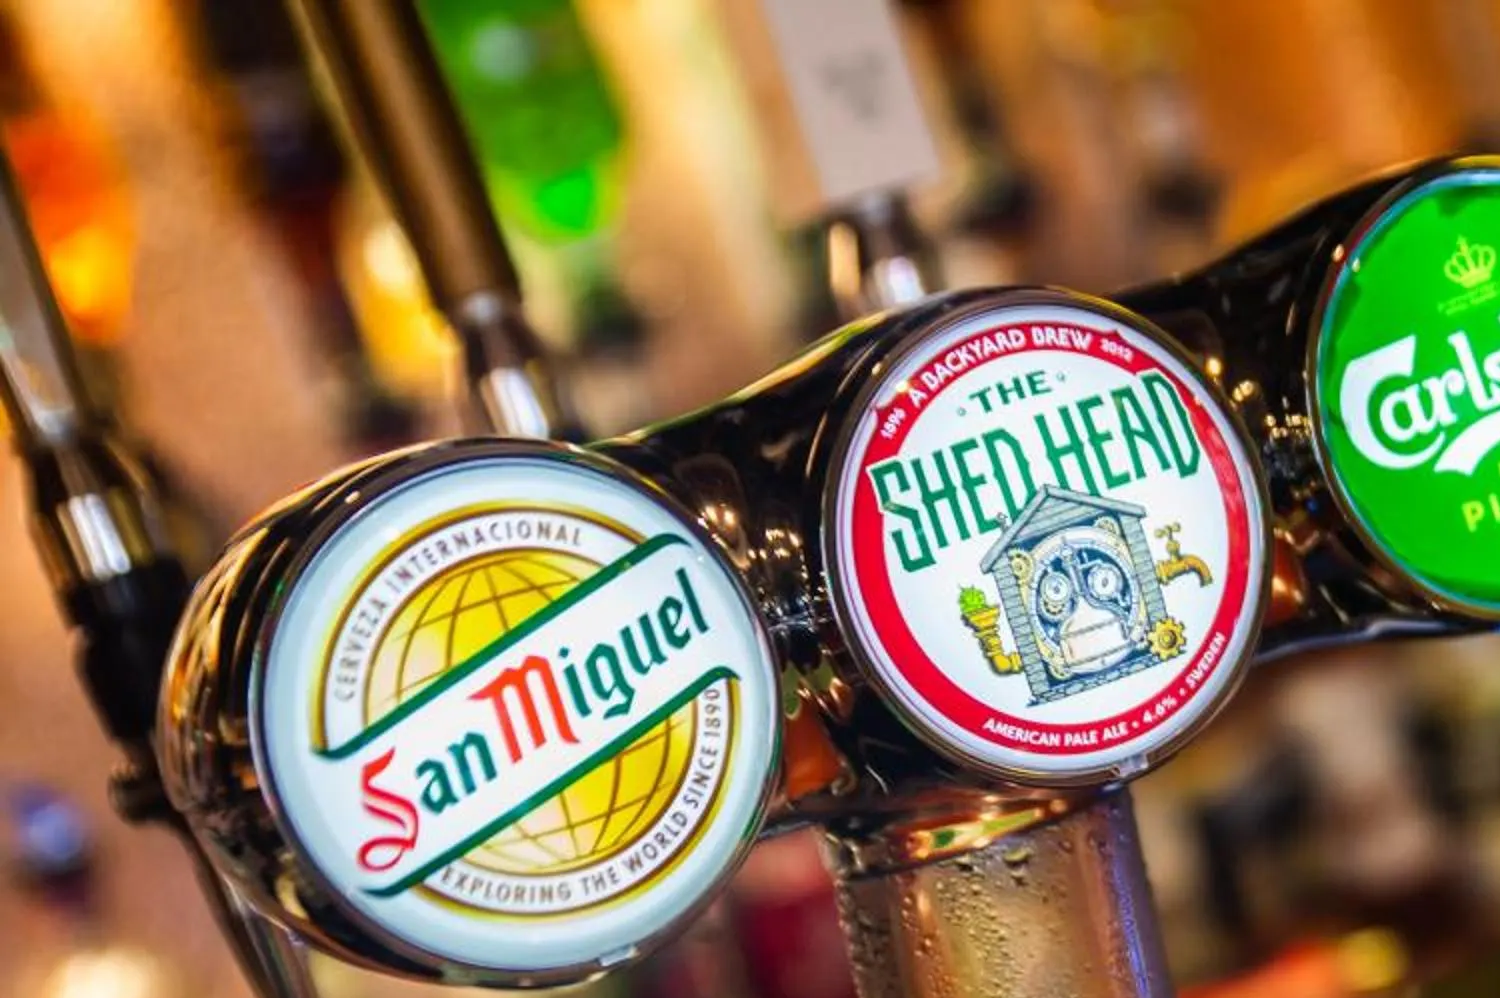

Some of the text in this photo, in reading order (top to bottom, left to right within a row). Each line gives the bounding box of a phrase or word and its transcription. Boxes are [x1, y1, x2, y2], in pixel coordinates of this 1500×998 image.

[906, 386, 929, 409] A
[920, 327, 1027, 393] BACKYARD
[1031, 325, 1093, 352] BREW
[970, 371, 1053, 415] THE
[871, 373, 1201, 574] SHED HEAD
[333, 519, 583, 702] CERVEZA INTERNACIONAL
[982, 631, 1227, 747] AMERICAN PALE ALE 4.6% SWEDEN
[356, 566, 710, 874] San Miguel
[440, 688, 722, 903] EXPLORING THE WORLD SINCE 1890
